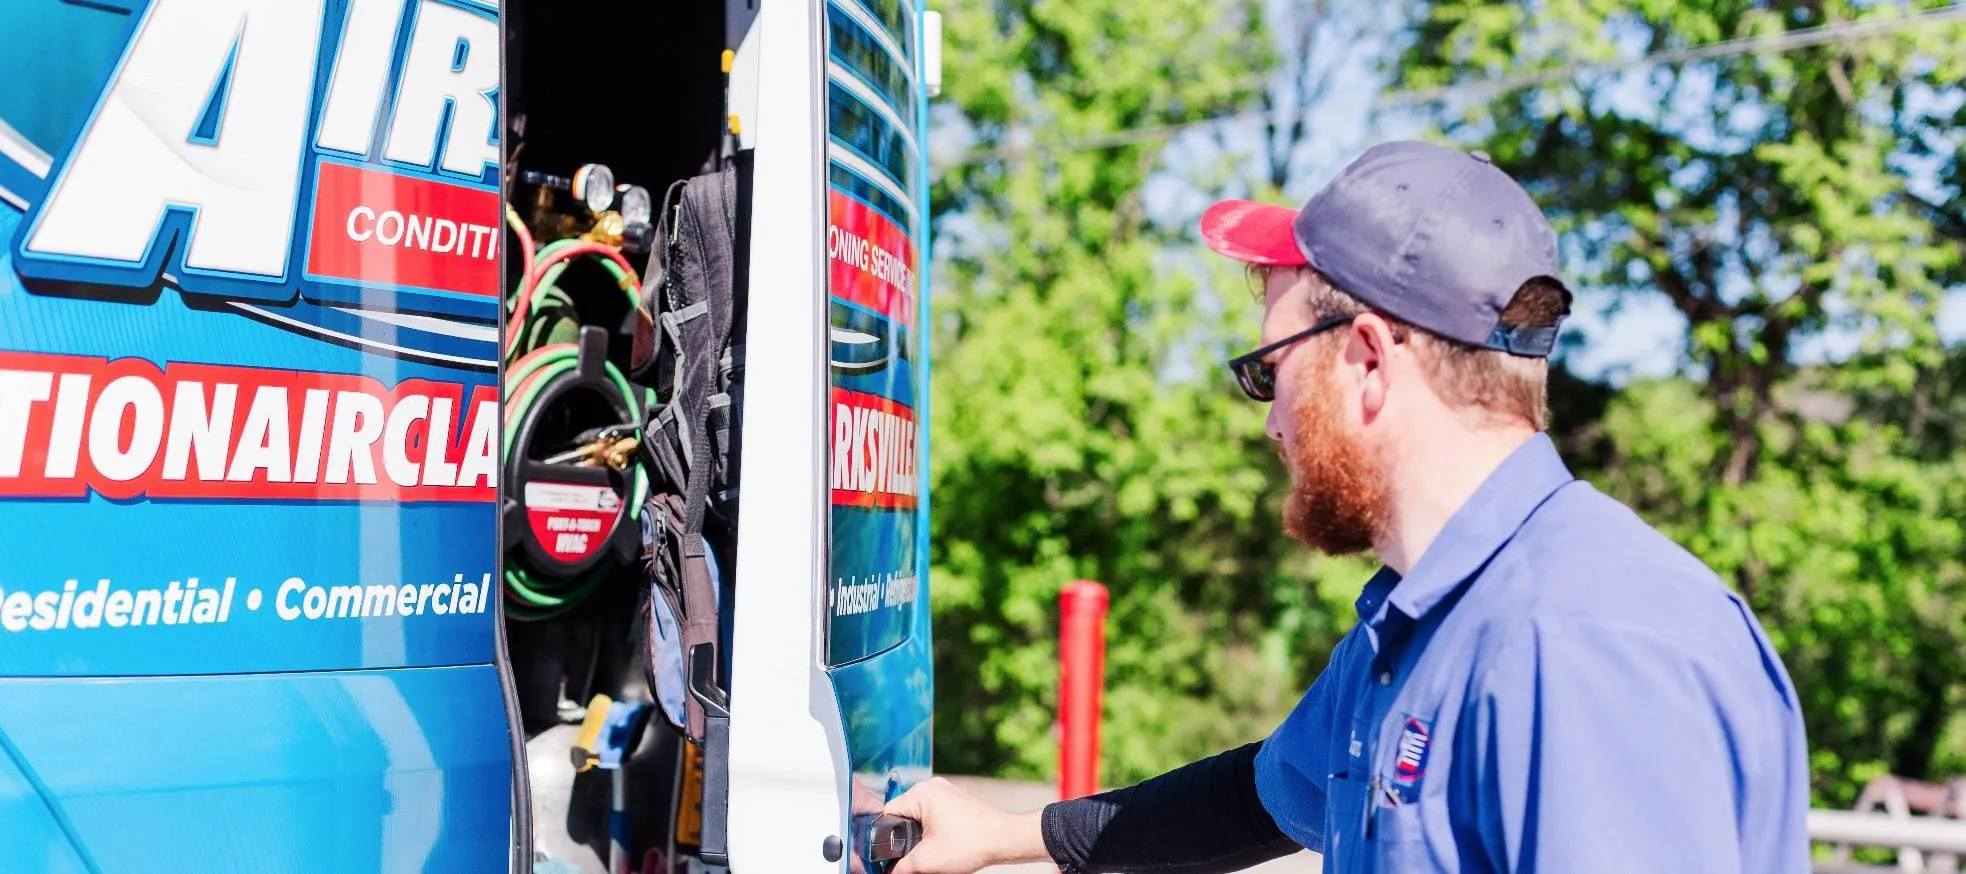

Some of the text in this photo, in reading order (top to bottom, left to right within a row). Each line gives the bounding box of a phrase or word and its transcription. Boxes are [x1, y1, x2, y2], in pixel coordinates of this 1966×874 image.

[346, 206, 498, 261] CONDITI
[832, 403, 917, 496] RKSVILLE
[0, 573, 491, 632] esidential Commercial
[837, 573, 881, 617] Industrial
